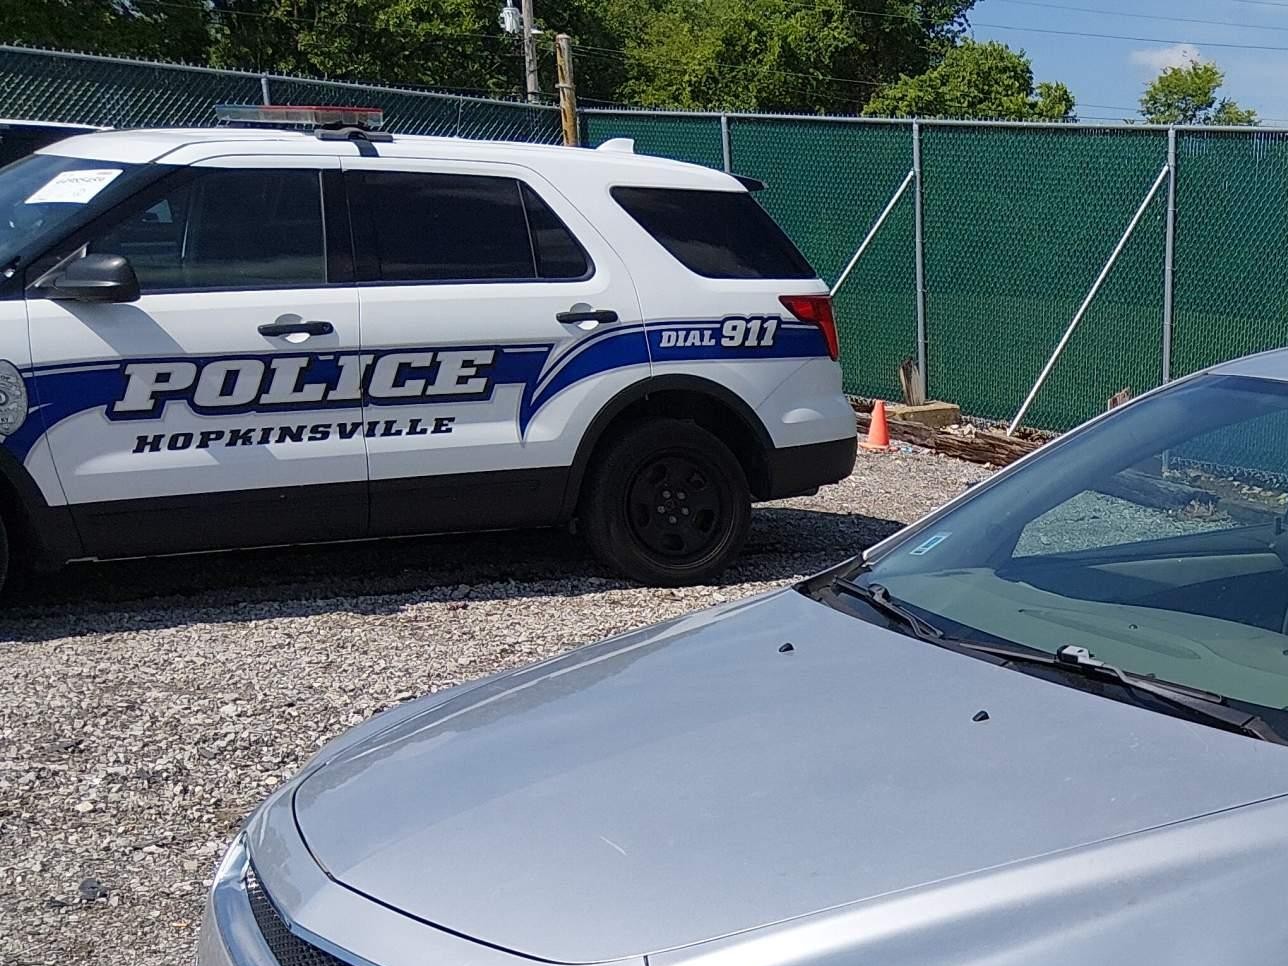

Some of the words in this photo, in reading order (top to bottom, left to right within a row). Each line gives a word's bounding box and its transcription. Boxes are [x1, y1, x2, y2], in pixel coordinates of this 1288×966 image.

[660, 329, 716, 348] DIAL
[720, 318, 779, 347] 911
[111, 349, 497, 413] POLICE
[132, 416, 456, 455] HOPKINSVILLE
